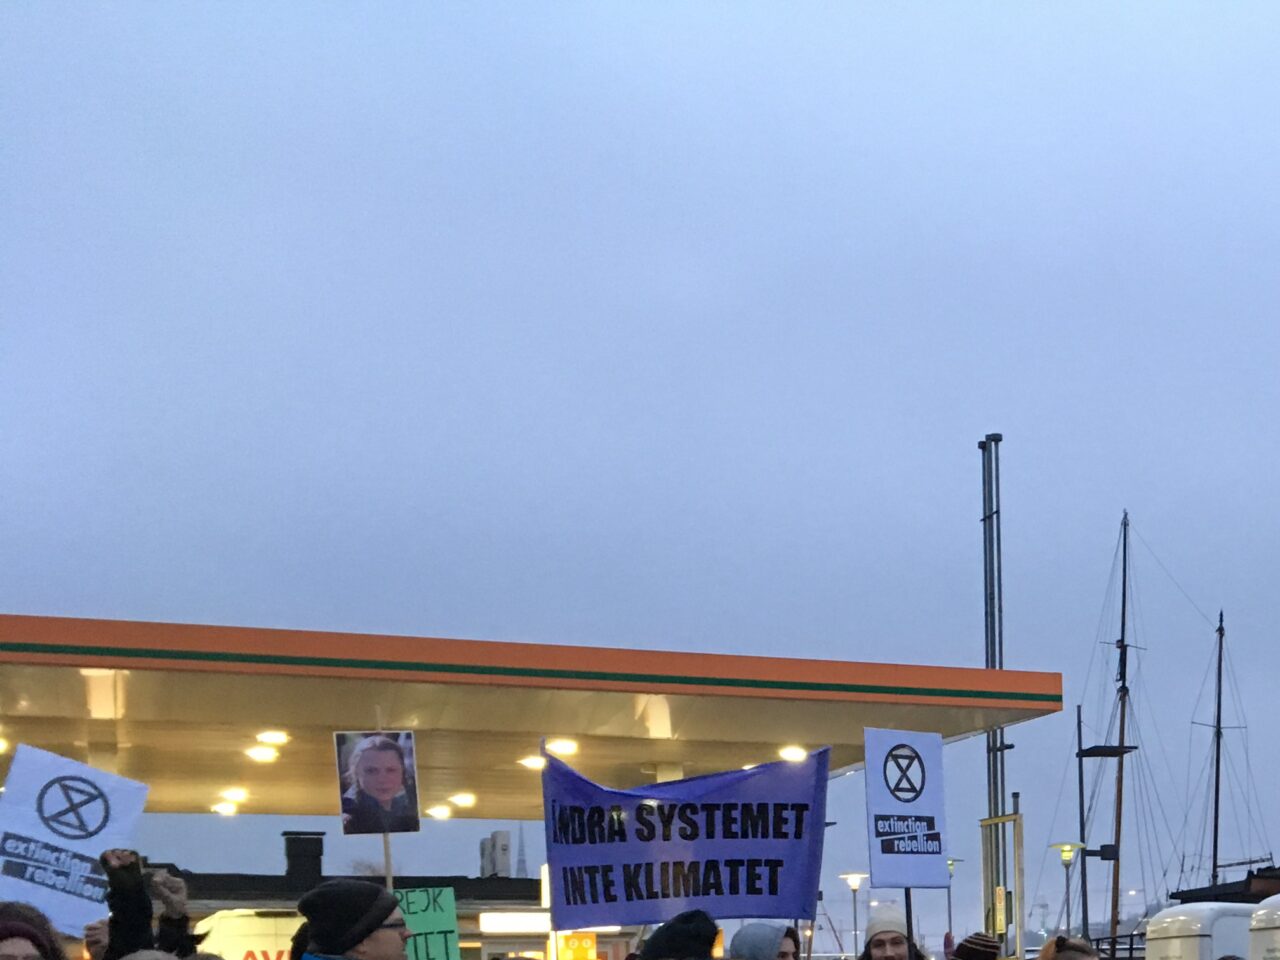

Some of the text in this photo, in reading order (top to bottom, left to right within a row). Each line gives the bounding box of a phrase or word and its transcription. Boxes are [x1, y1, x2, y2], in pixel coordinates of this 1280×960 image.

[635, 803, 810, 842] SYSTEMET
[877, 816, 928, 833] extinction
[3, 838, 92, 876] extinction
[894, 832, 939, 853] rebellion
[24, 866, 106, 900] rebellion
[562, 859, 785, 906] INTE KLIMATET
[393, 888, 444, 914] REJK
